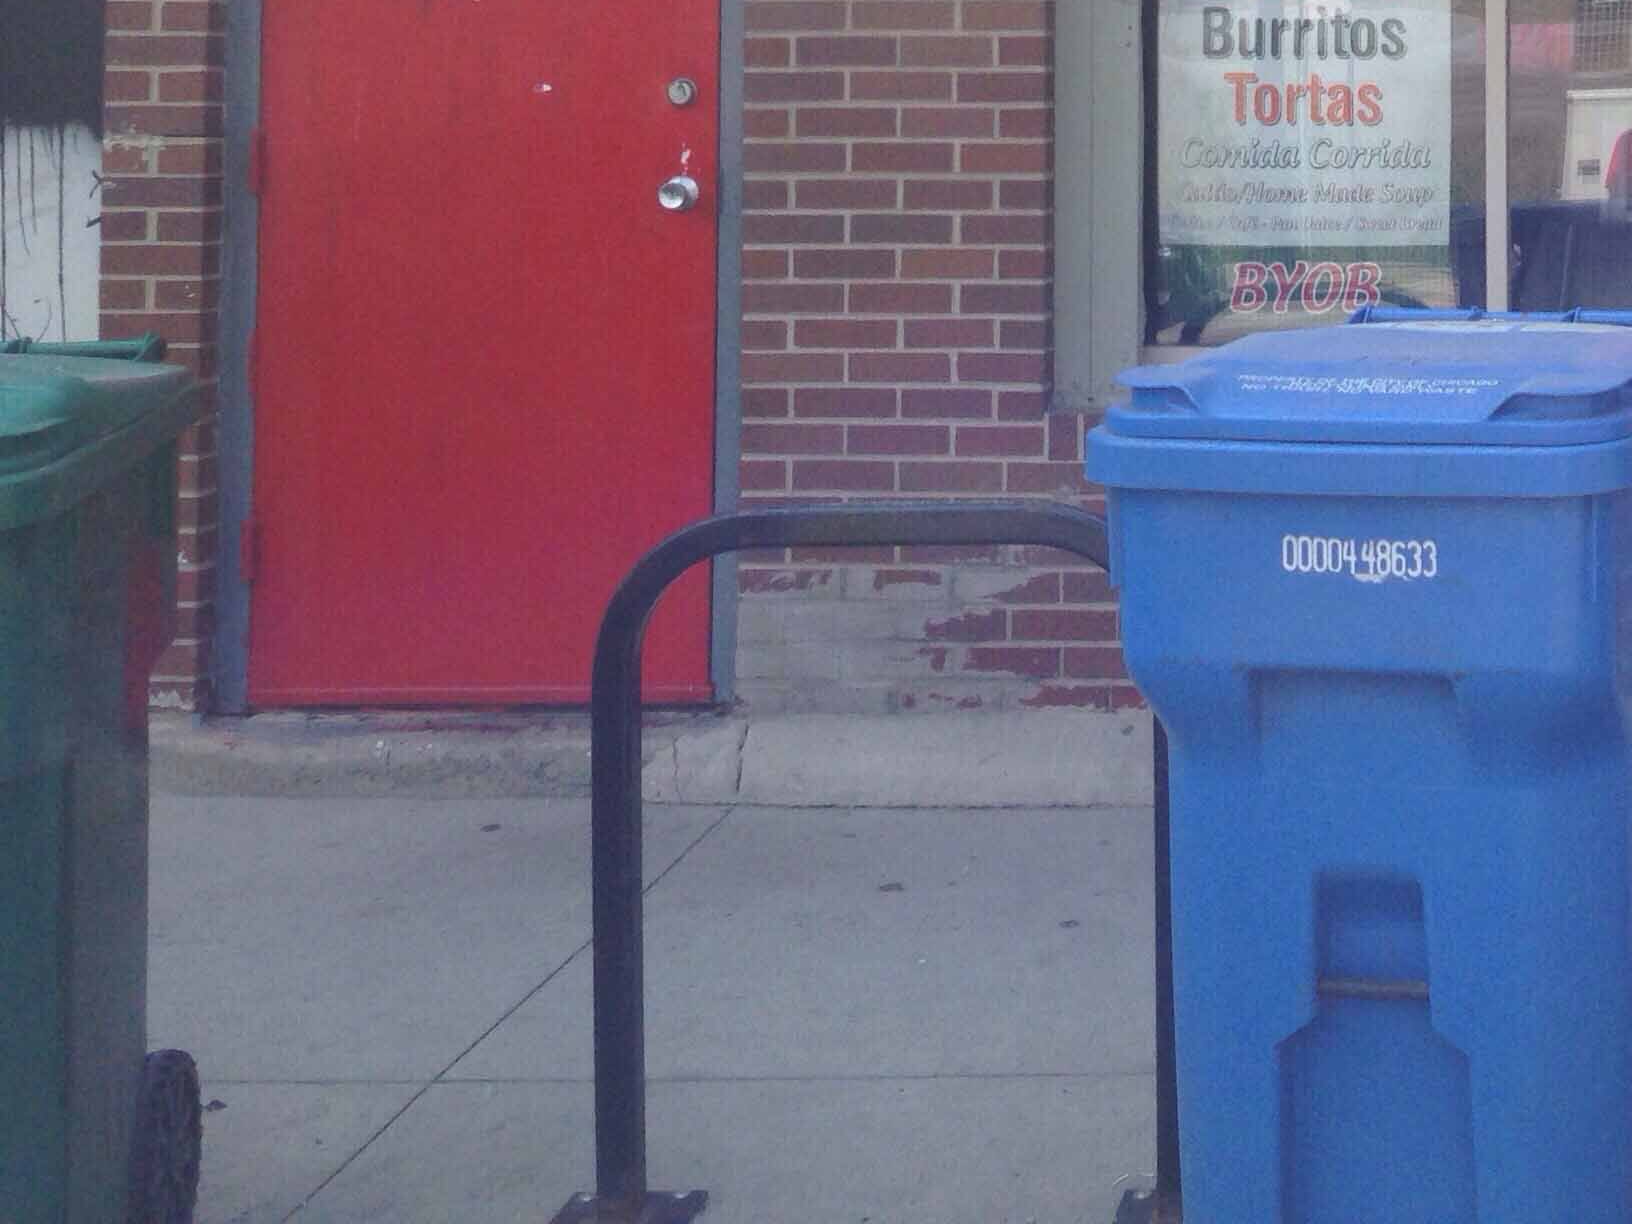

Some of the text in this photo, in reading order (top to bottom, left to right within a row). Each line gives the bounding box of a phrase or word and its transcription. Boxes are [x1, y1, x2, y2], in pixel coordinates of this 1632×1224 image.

[1202, 6, 1408, 61] Burritos
[1223, 72, 1384, 127] Tortas
[1308, 137, 1432, 169] Corrida
[1229, 260, 1383, 314] BYOB
[1282, 535, 1437, 577] 0000448633
